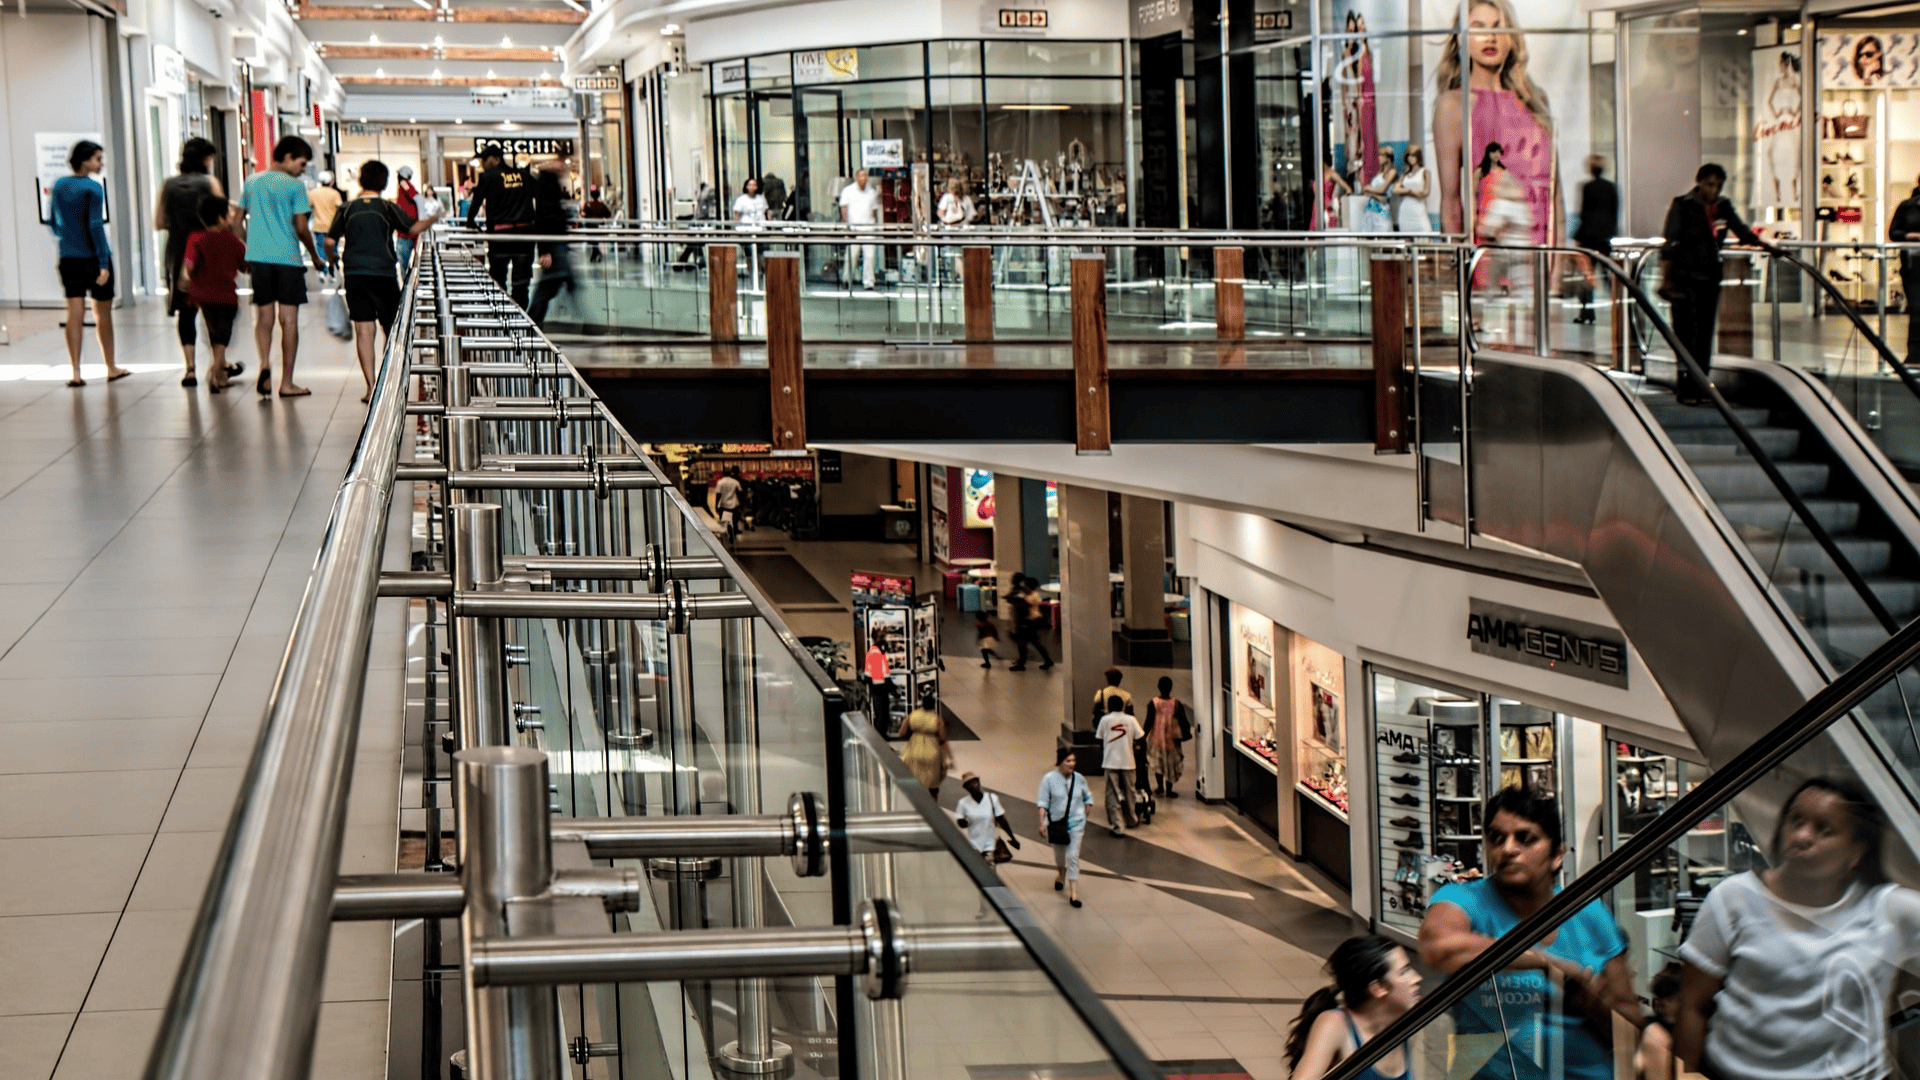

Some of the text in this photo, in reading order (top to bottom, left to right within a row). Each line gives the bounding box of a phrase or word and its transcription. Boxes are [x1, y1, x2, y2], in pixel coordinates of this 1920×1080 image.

[1466, 613, 1622, 675] AMA GENTS
[1378, 727, 1415, 753] AMA
